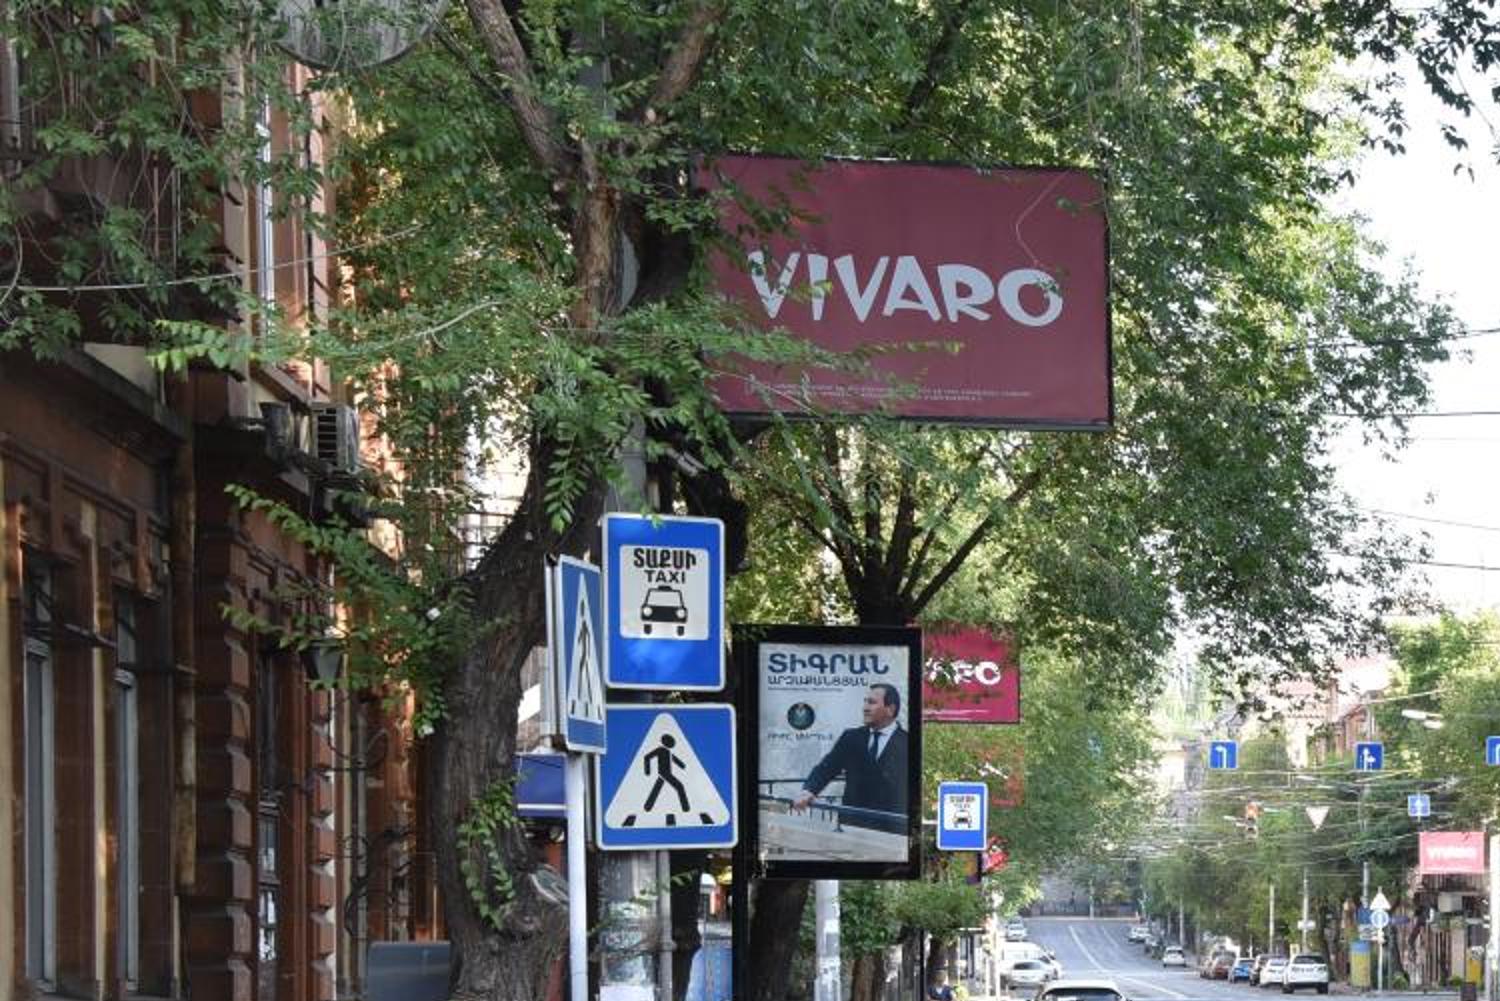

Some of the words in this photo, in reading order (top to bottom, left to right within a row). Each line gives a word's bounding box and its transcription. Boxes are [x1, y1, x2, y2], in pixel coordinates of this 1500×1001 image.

[748, 250, 1063, 327] VIVARO
[633, 547, 697, 570] ՏԱՔՍԻ
[644, 569, 686, 584] TAXI
[767, 652, 890, 675] ՏԻԳՐԱՆ
